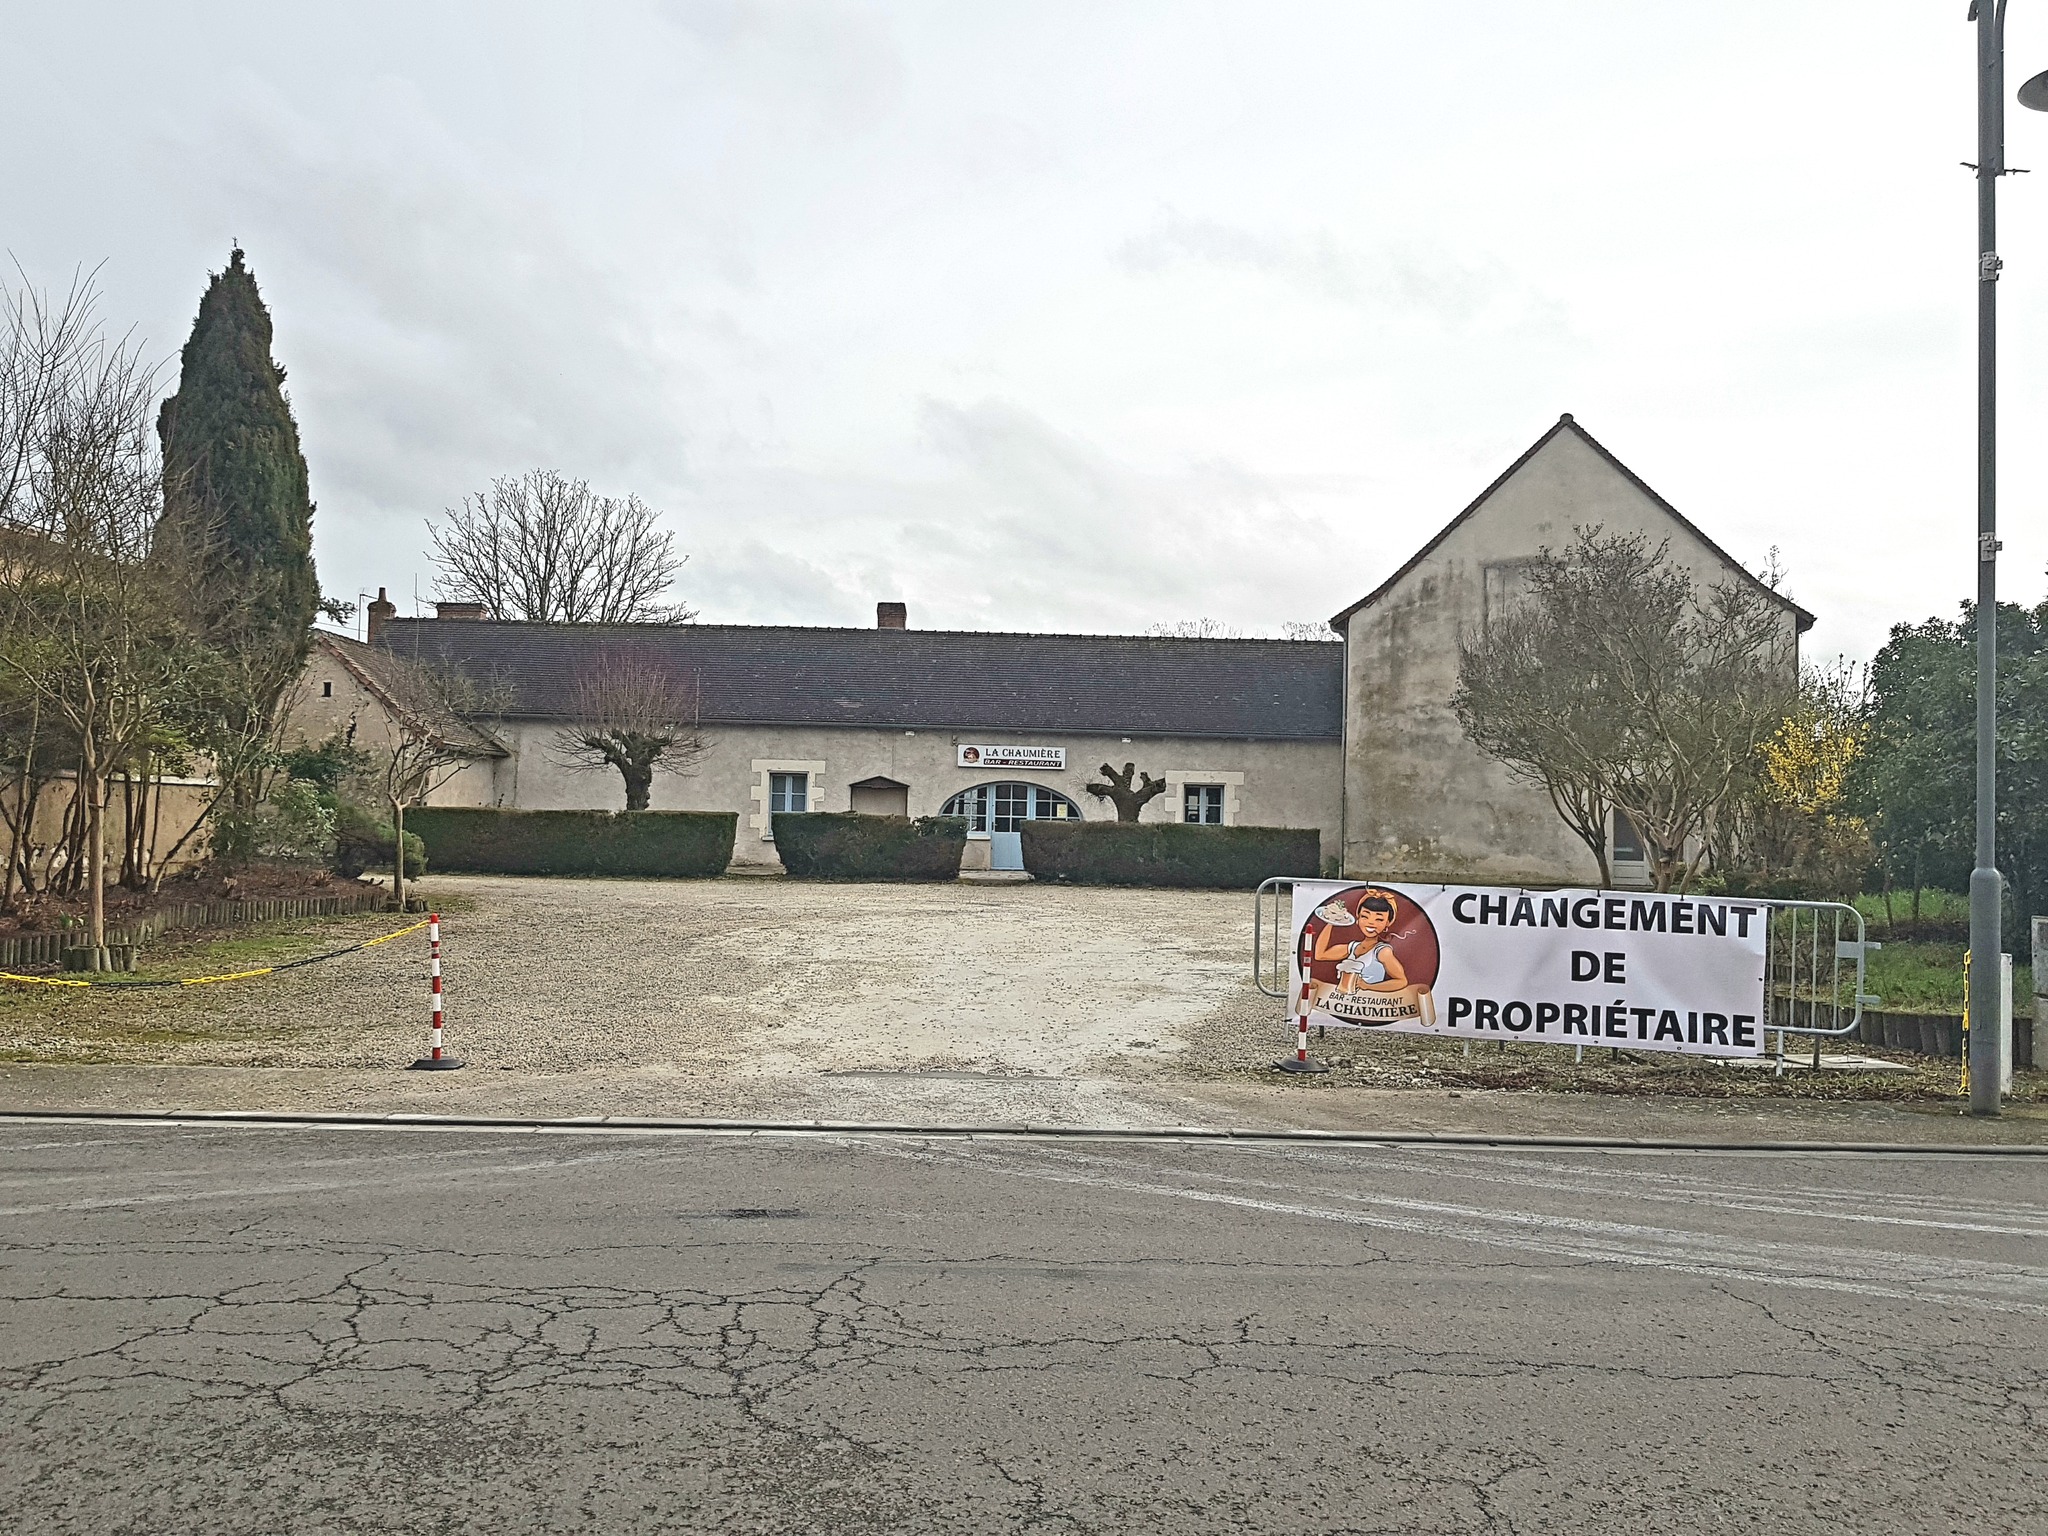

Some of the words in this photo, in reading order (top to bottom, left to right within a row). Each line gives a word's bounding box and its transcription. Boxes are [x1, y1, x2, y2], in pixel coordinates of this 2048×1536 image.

[985, 748, 999, 756] LA
[1002, 748, 1060, 758] CHAUMIÈRE
[1452, 893, 1757, 938] CHANGEMENT
[1571, 950, 1626, 984] DE
[1315, 998, 1330, 1009] LA
[1328, 992, 1345, 1001] BAR
[1351, 996, 1404, 1006] RESTAURANT
[1447, 997, 1756, 1048] PROPRIÉTAIRE
